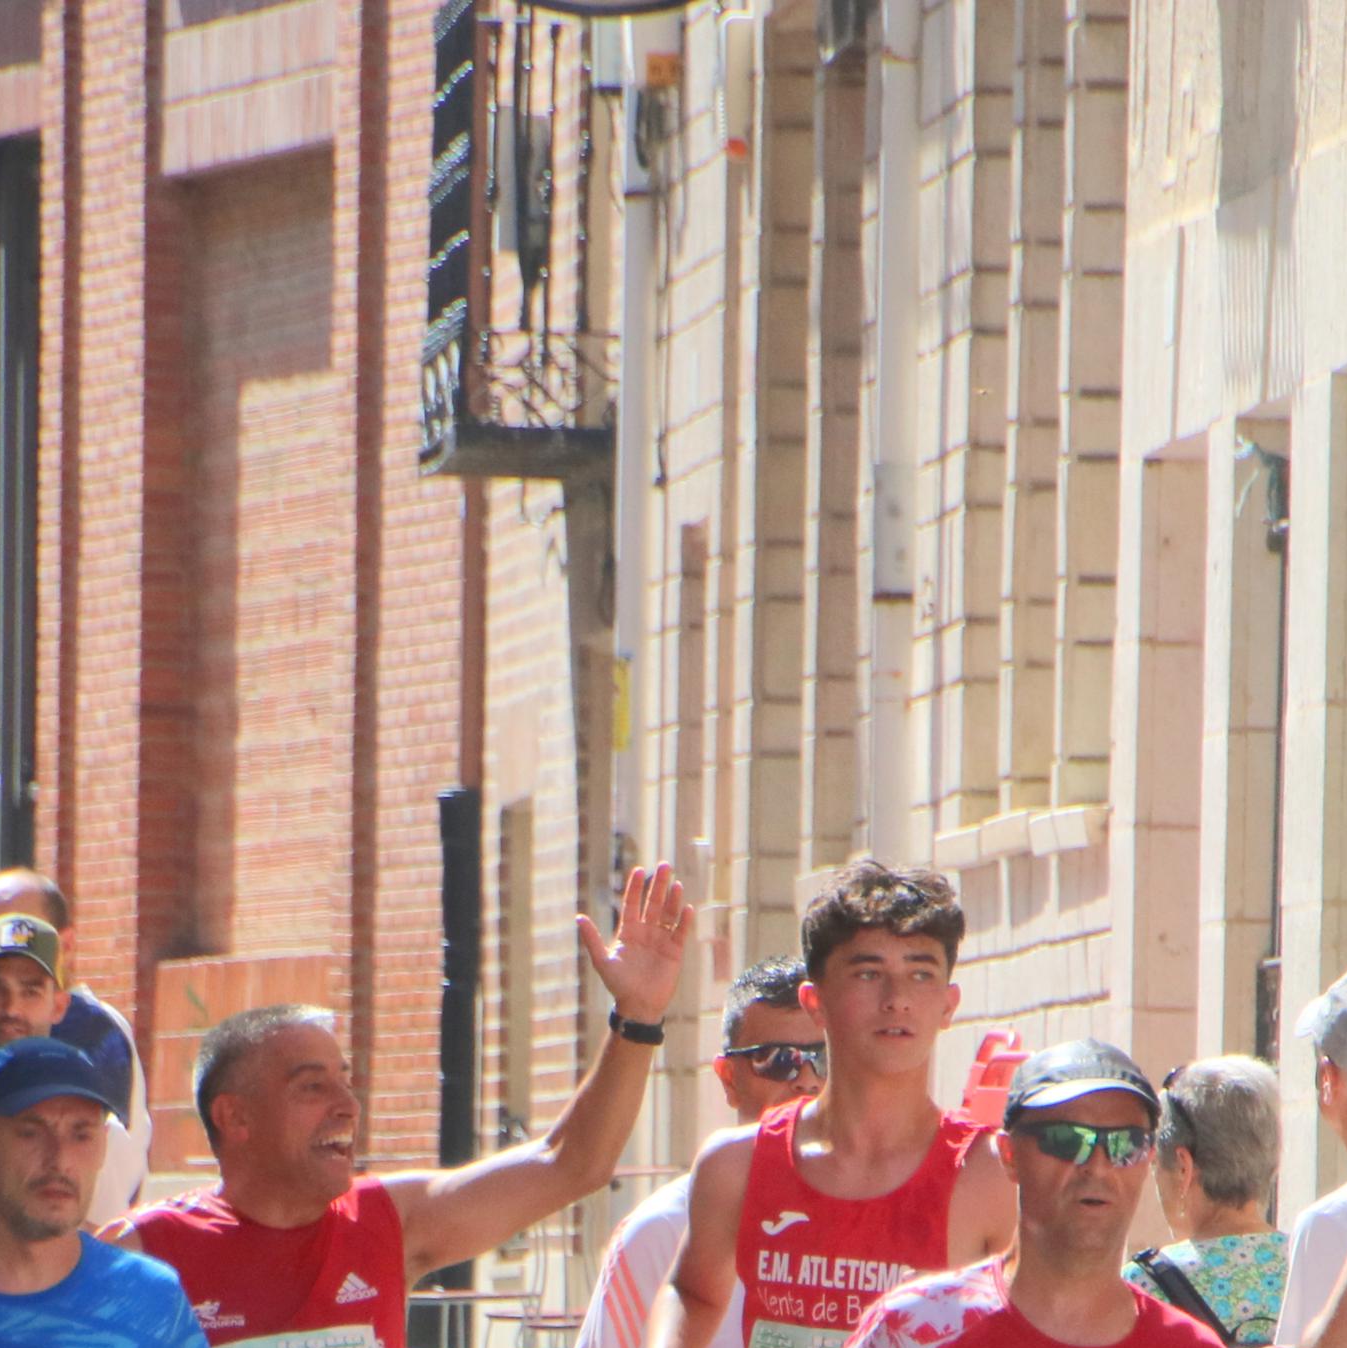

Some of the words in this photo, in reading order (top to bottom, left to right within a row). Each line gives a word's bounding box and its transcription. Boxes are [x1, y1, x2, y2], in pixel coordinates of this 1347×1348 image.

[757, 1250, 793, 1284] E.M.
[335, 1287, 378, 1304] adidas
[756, 1286, 805, 1319] Venta
[812, 1294, 839, 1322] de
